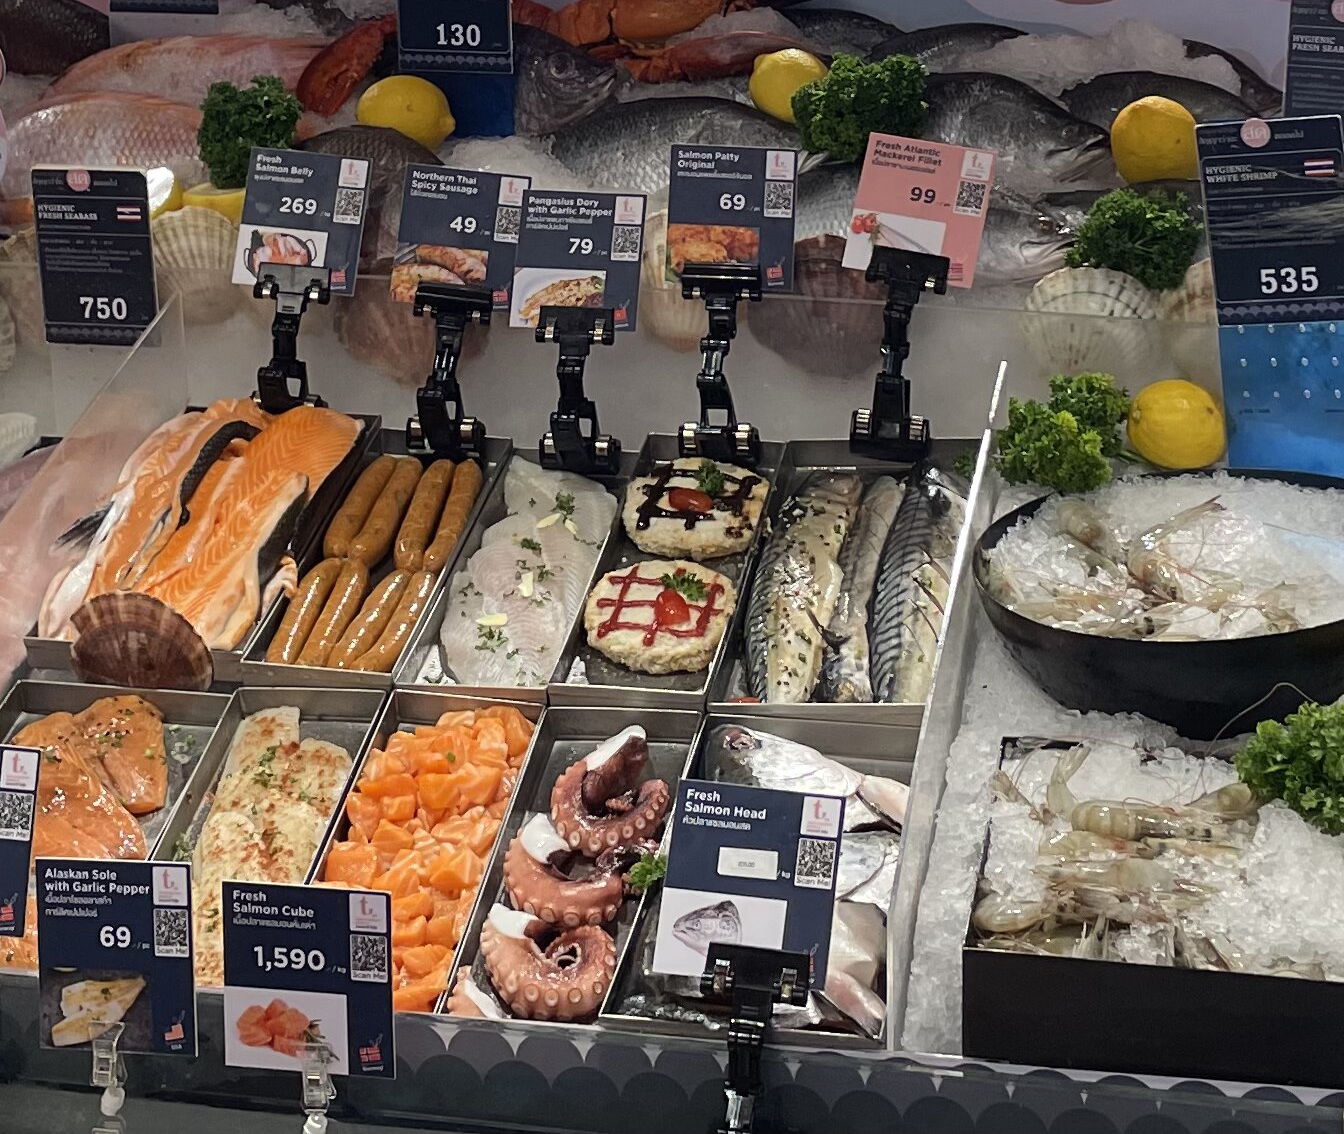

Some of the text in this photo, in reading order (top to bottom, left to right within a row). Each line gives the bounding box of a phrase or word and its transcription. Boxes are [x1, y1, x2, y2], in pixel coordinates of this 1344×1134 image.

[436, 23, 481, 47] 130
[1292, 34, 1337, 45] HYGIENIC
[1292, 43, 1321, 53] FRESH
[875, 139, 941, 157] Fresh Atlantic
[256, 154, 282, 164] Fresh
[678, 150, 740, 163] Salmon Patty
[873, 149, 916, 163] Mackerel
[917, 155, 942, 167] Fillet
[255, 163, 314, 178] Salmon Belly
[677, 159, 716, 170] Original
[1205, 164, 1252, 175] HYGIENIC
[412, 170, 477, 185] Northern Thai
[1206, 171, 1278, 184] WHITE SHRIMP
[411, 179, 438, 192] Spicy
[439, 182, 478, 195] Sausage
[528, 196, 599, 208] Pangasius Dory
[719, 193, 746, 211] 69
[909, 186, 937, 204] 99
[279, 197, 318, 215] 269
[528, 205, 613, 217] with Garlic Pepper
[449, 216, 477, 234] 49
[568, 237, 594, 255] 79
[1260, 266, 1320, 295] 535
[79, 296, 128, 320] 750
[686, 789, 721, 803] Fresh
[684, 801, 767, 820] Salmon Head
[44, 868, 117, 880] Alaskan Sole
[45, 881, 150, 895] with Garlic Pepper
[232, 889, 267, 902] Fresh
[232, 902, 315, 918] Salmon Cube
[99, 925, 131, 948] 69
[253, 945, 326, 972] 1,590
